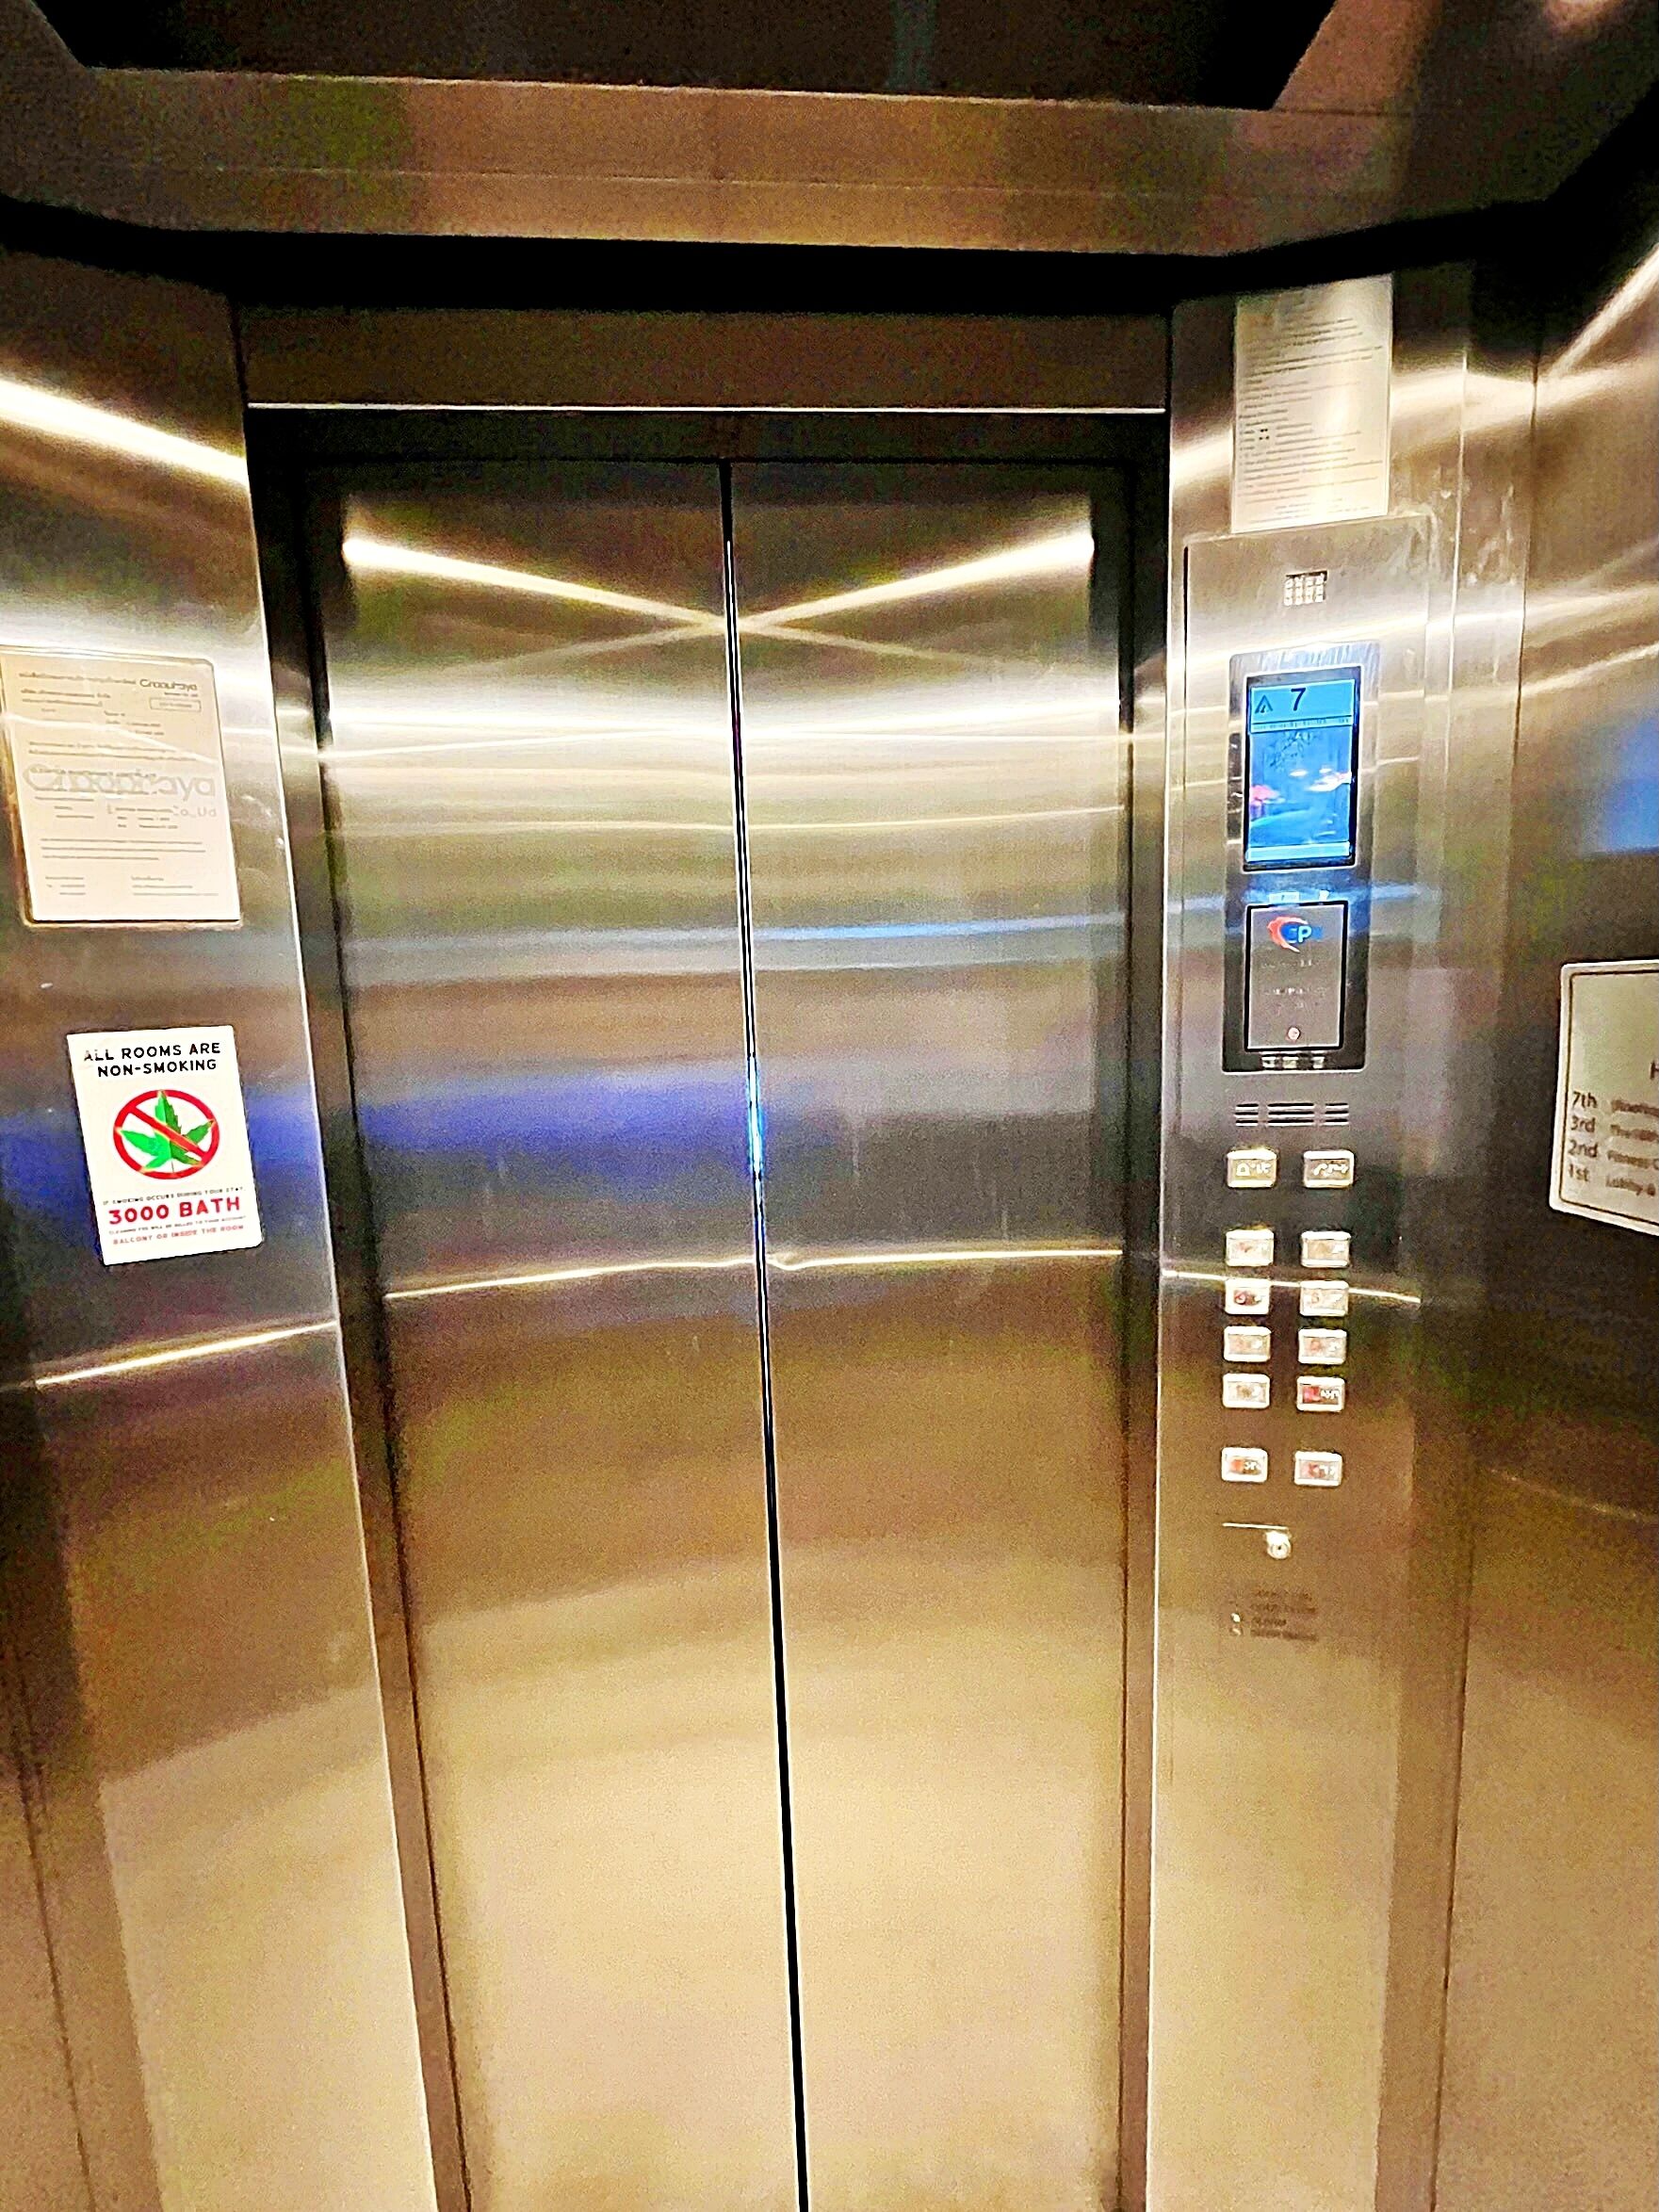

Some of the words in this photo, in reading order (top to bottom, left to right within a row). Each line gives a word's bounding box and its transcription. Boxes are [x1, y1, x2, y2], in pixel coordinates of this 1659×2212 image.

[1291, 687, 1307, 711] 7
[83, 1049, 115, 1062] ALL
[122, 1044, 182, 1059] ROOMS
[189, 1042, 221, 1055] ARE
[97, 1058, 217, 1077] NON-SMOKING
[1572, 1091, 1598, 1110] 7th
[1570, 1115, 1596, 1133] 3rd
[1568, 1139, 1598, 1158] 2nd
[1569, 1163, 1590, 1182] 1st
[108, 1204, 169, 1225] 3000
[179, 1196, 239, 1217] BATH
